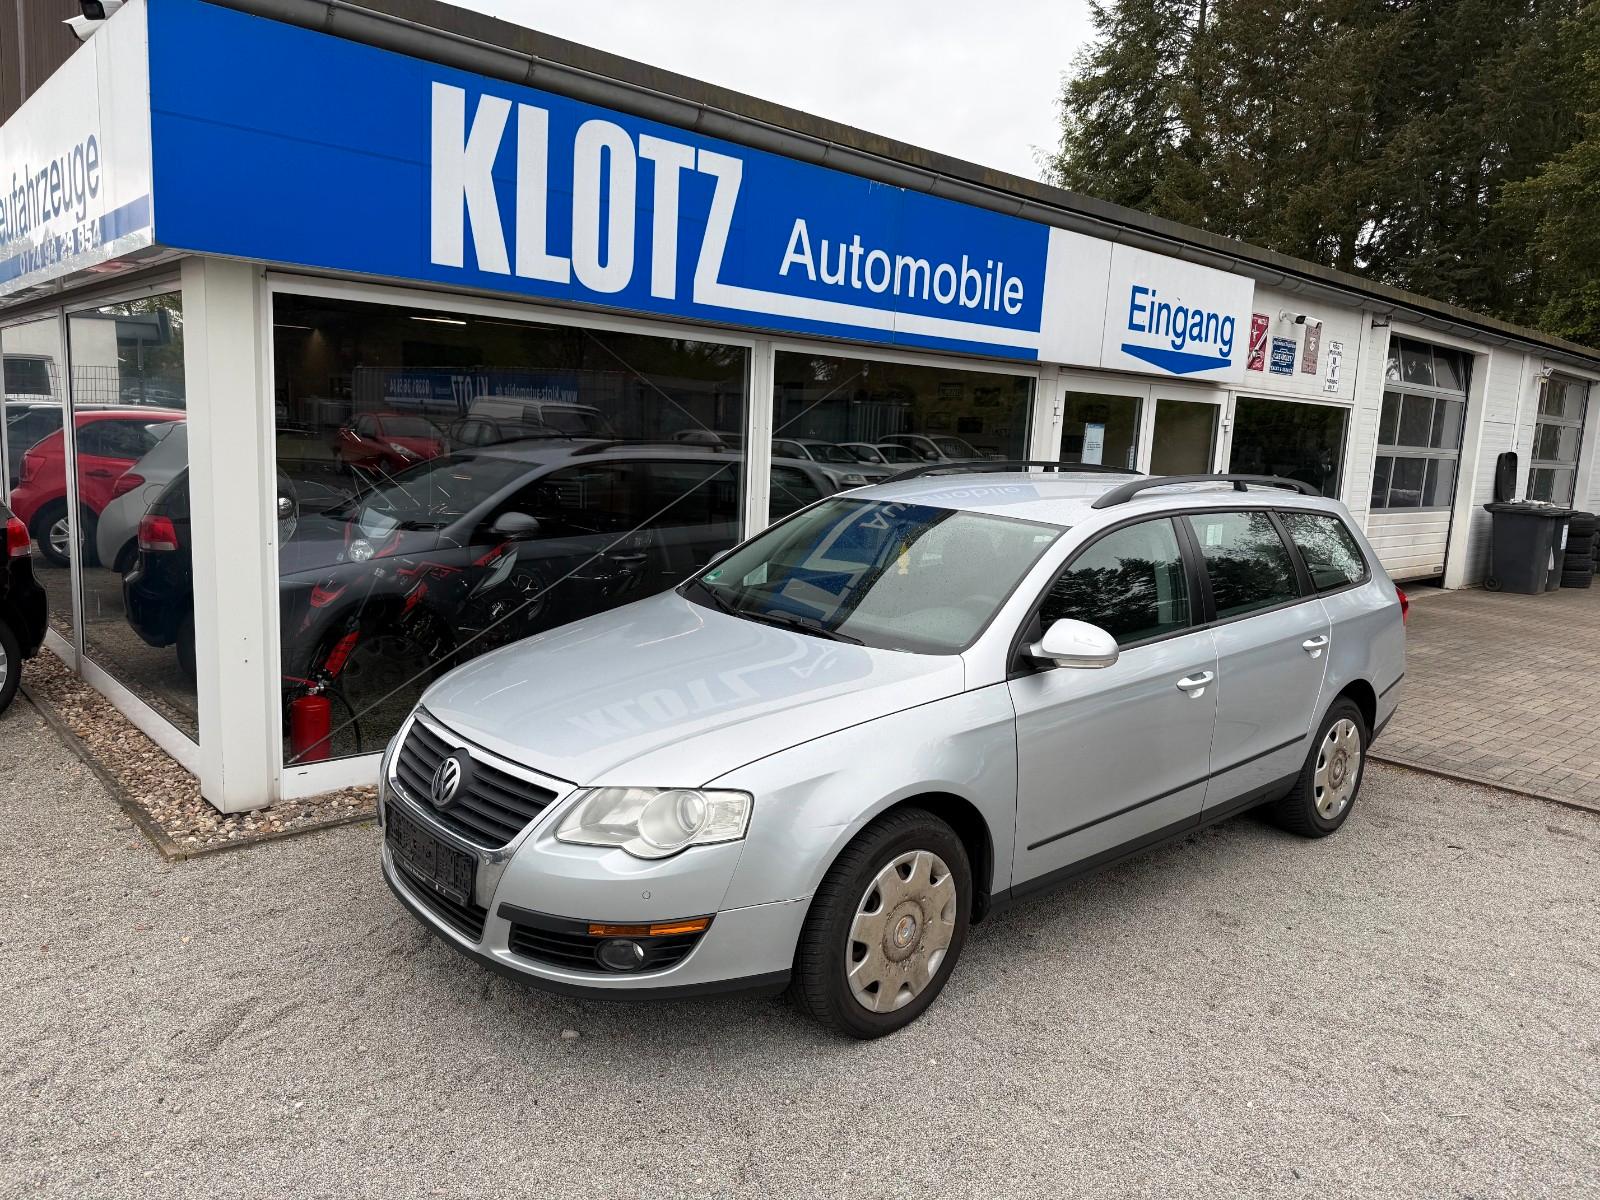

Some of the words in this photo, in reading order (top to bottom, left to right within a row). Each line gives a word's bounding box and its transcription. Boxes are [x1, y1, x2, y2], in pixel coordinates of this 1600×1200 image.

[431, 81, 743, 304] KLOTZ
[779, 218, 1024, 315] Automobile
[1128, 285, 1235, 357] Eingang
